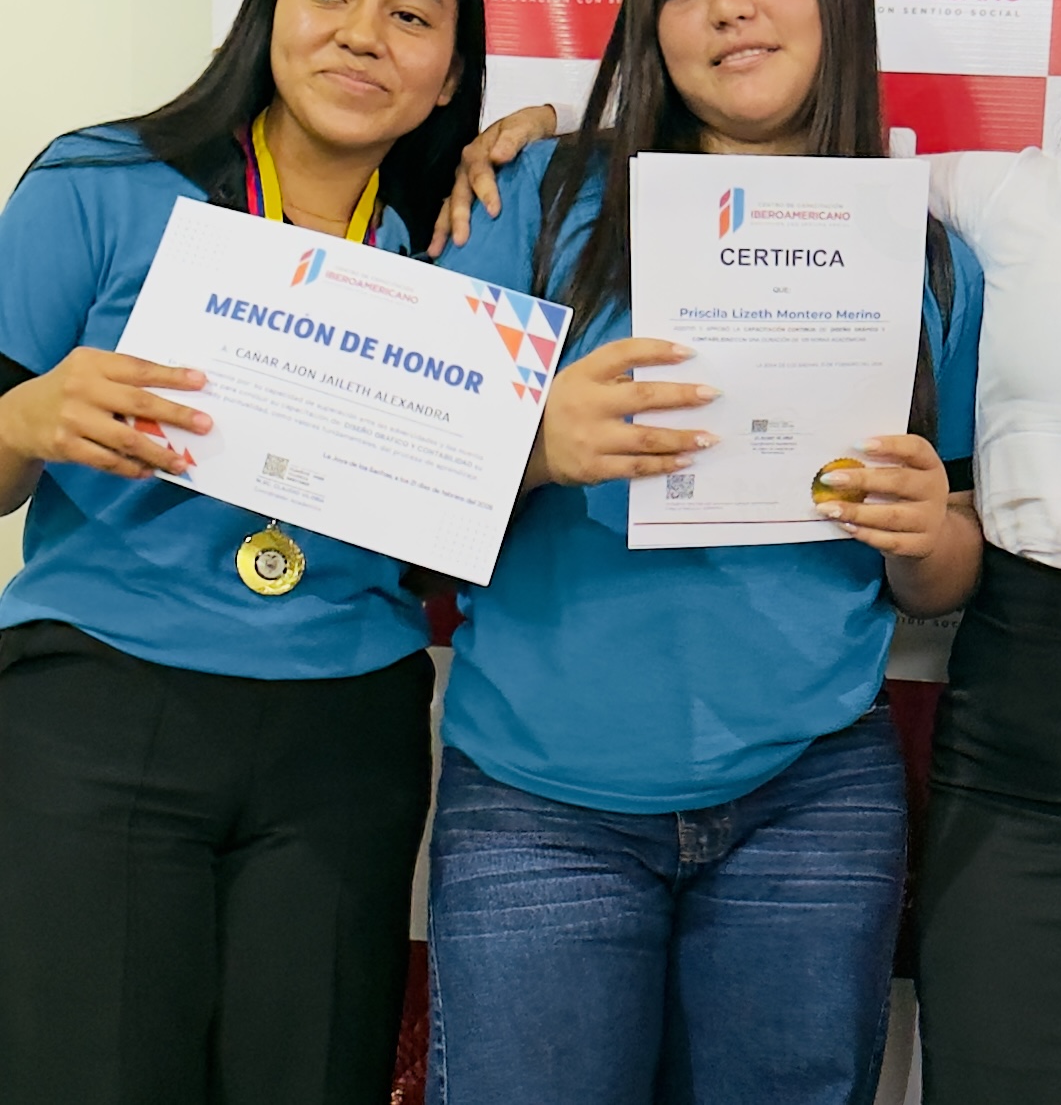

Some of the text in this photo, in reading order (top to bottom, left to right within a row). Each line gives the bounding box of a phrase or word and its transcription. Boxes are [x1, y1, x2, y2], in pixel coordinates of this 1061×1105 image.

[904, 7, 962, 16] SENTIDO
[971, 9, 1020, 17] SOCIAL
[750, 210, 850, 220] IBEROAMERICANO
[720, 248, 844, 267] CERTIFICA
[680, 308, 880, 320] Priscila Lizeth Montero Merino
[205, 293, 484, 394] MENCIÓN DE HONOR
[320, 373, 370, 397] JAILETH
[374, 390, 450, 422] ALEXANDRA
